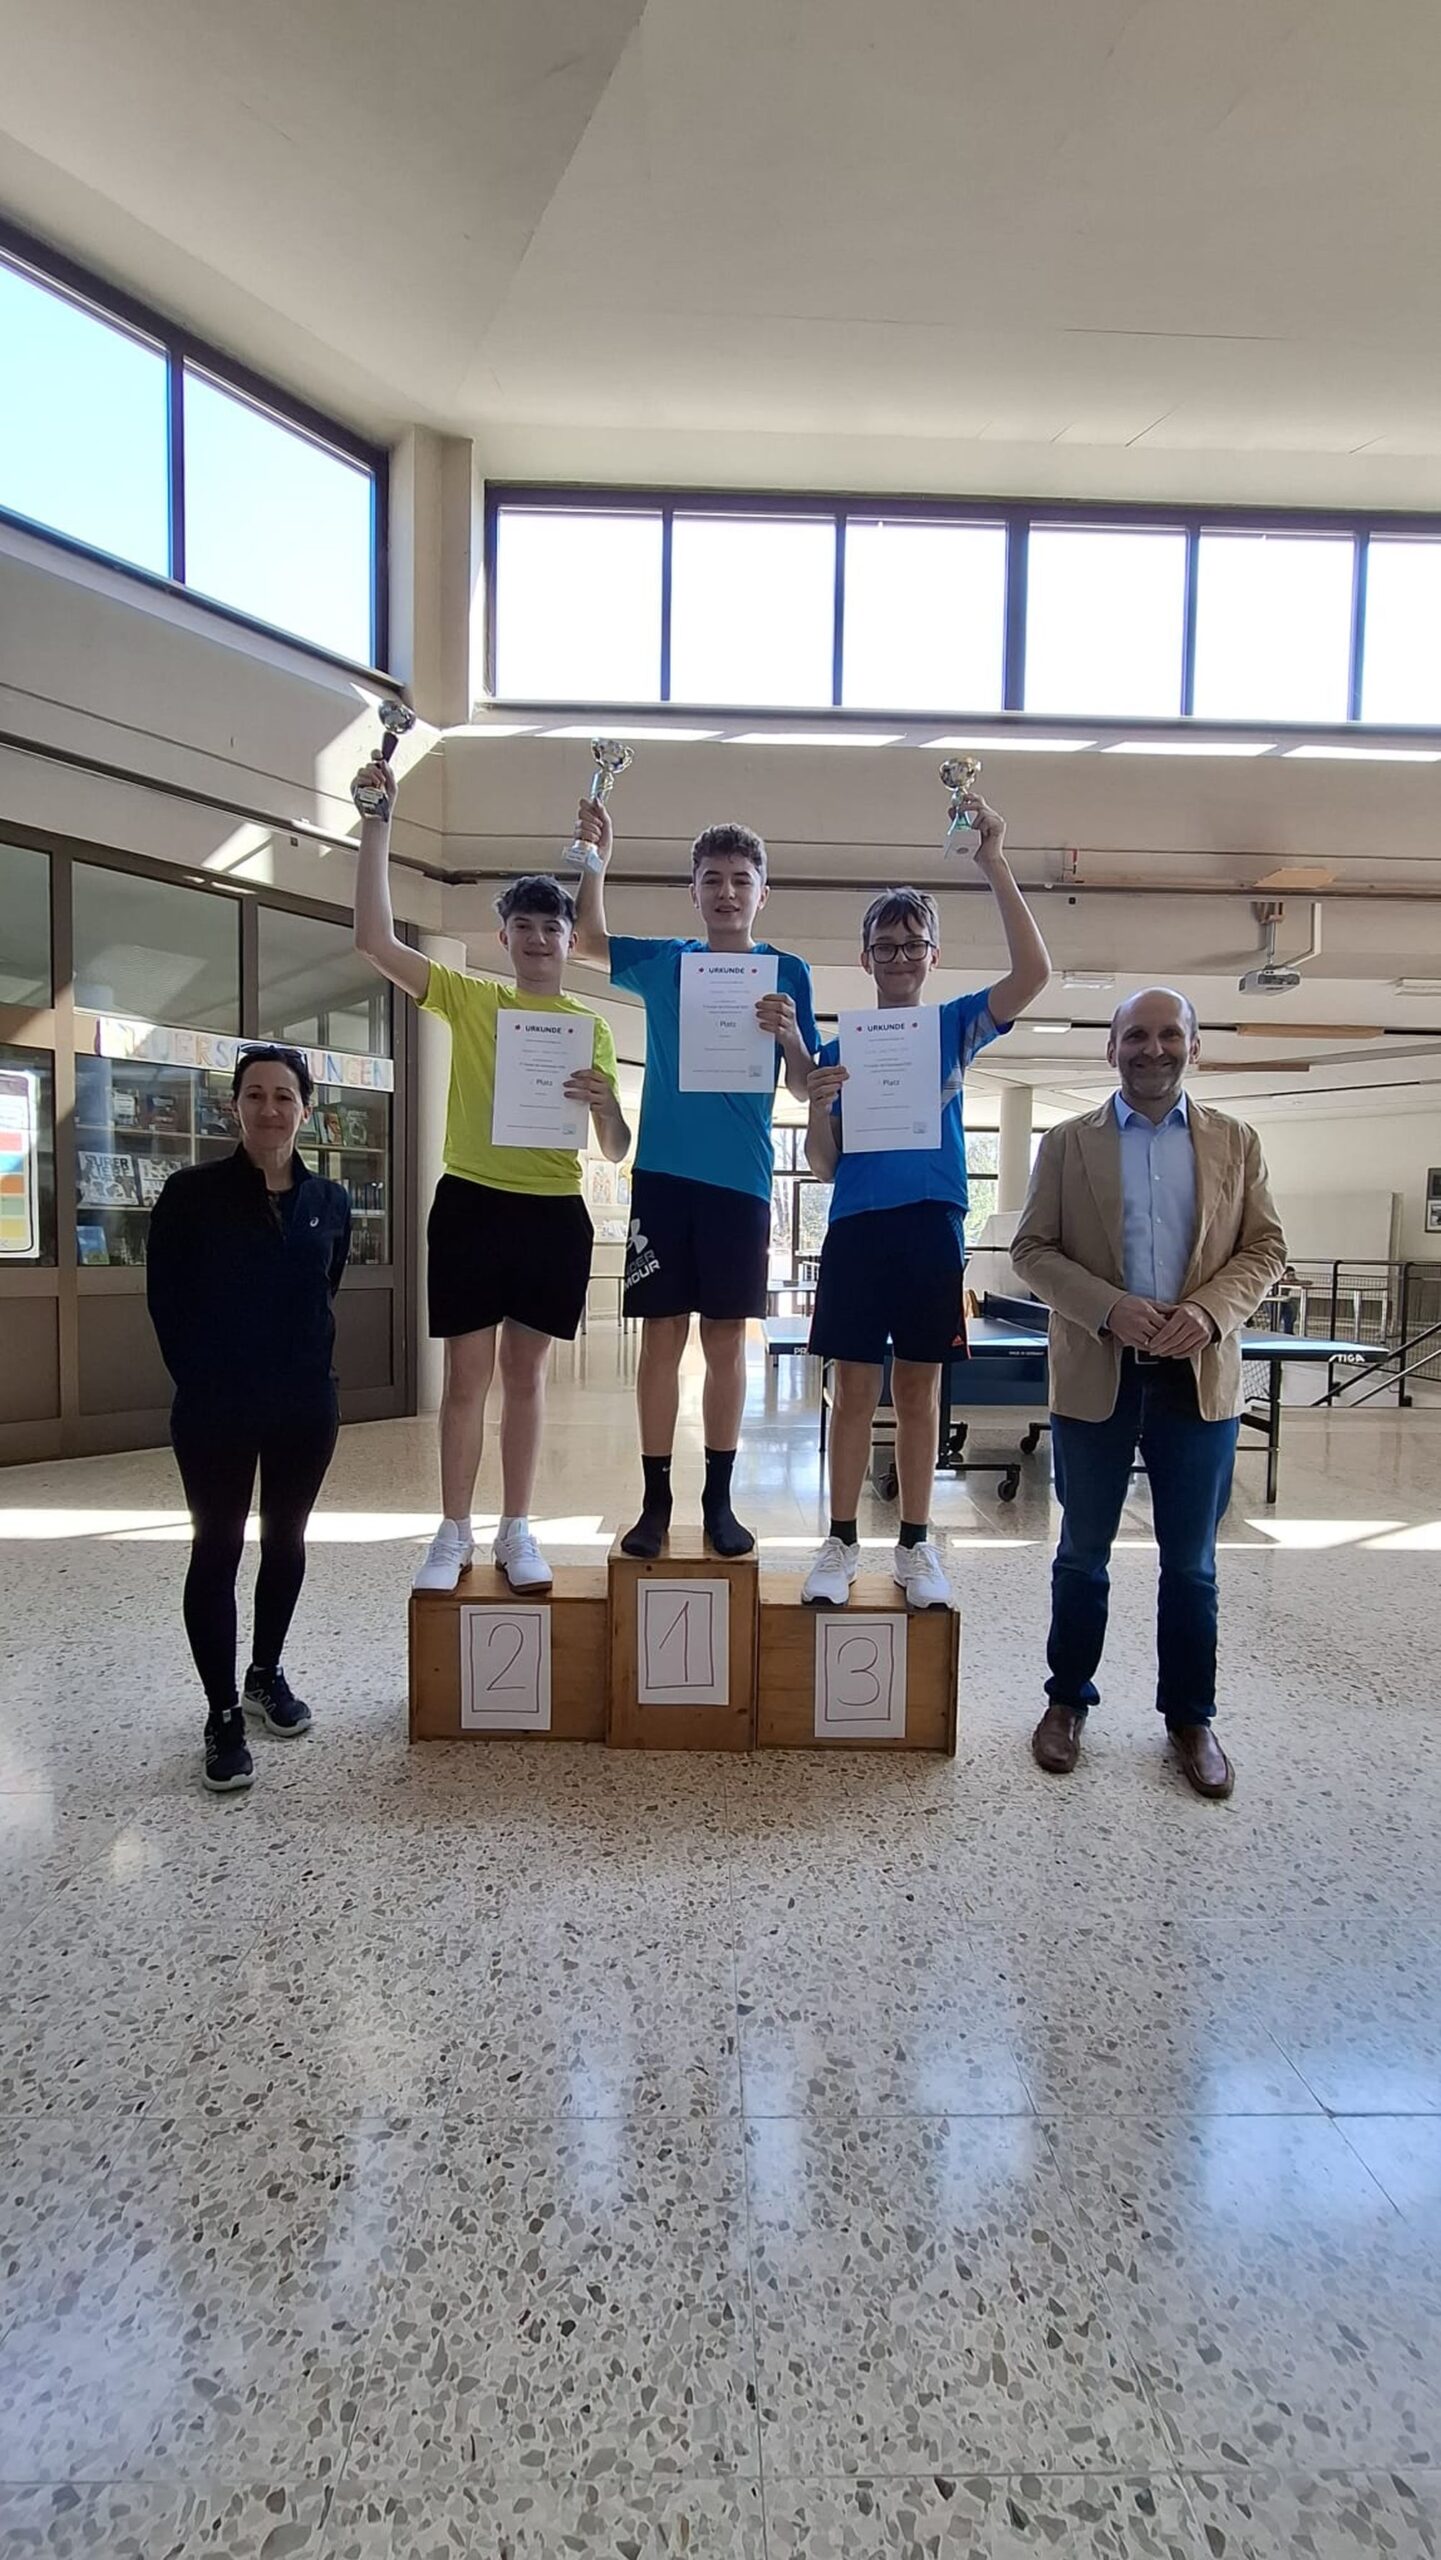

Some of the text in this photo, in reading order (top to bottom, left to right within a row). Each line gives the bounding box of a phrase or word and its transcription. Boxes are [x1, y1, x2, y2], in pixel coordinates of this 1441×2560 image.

[708, 966, 745, 974] URKUNDE
[719, 1020, 737, 1028] Platz
[867, 1023, 905, 1032] URKUNDE
[525, 1025, 562, 1034] URKUNDE
[535, 1078, 553, 1087] Platz
[882, 1079, 900, 1087] Platz
[1329, 1354, 1365, 1363] STIGA
[659, 1600, 690, 1682] 1
[487, 1622, 527, 1691] 2
[837, 1637, 880, 1706] 3
